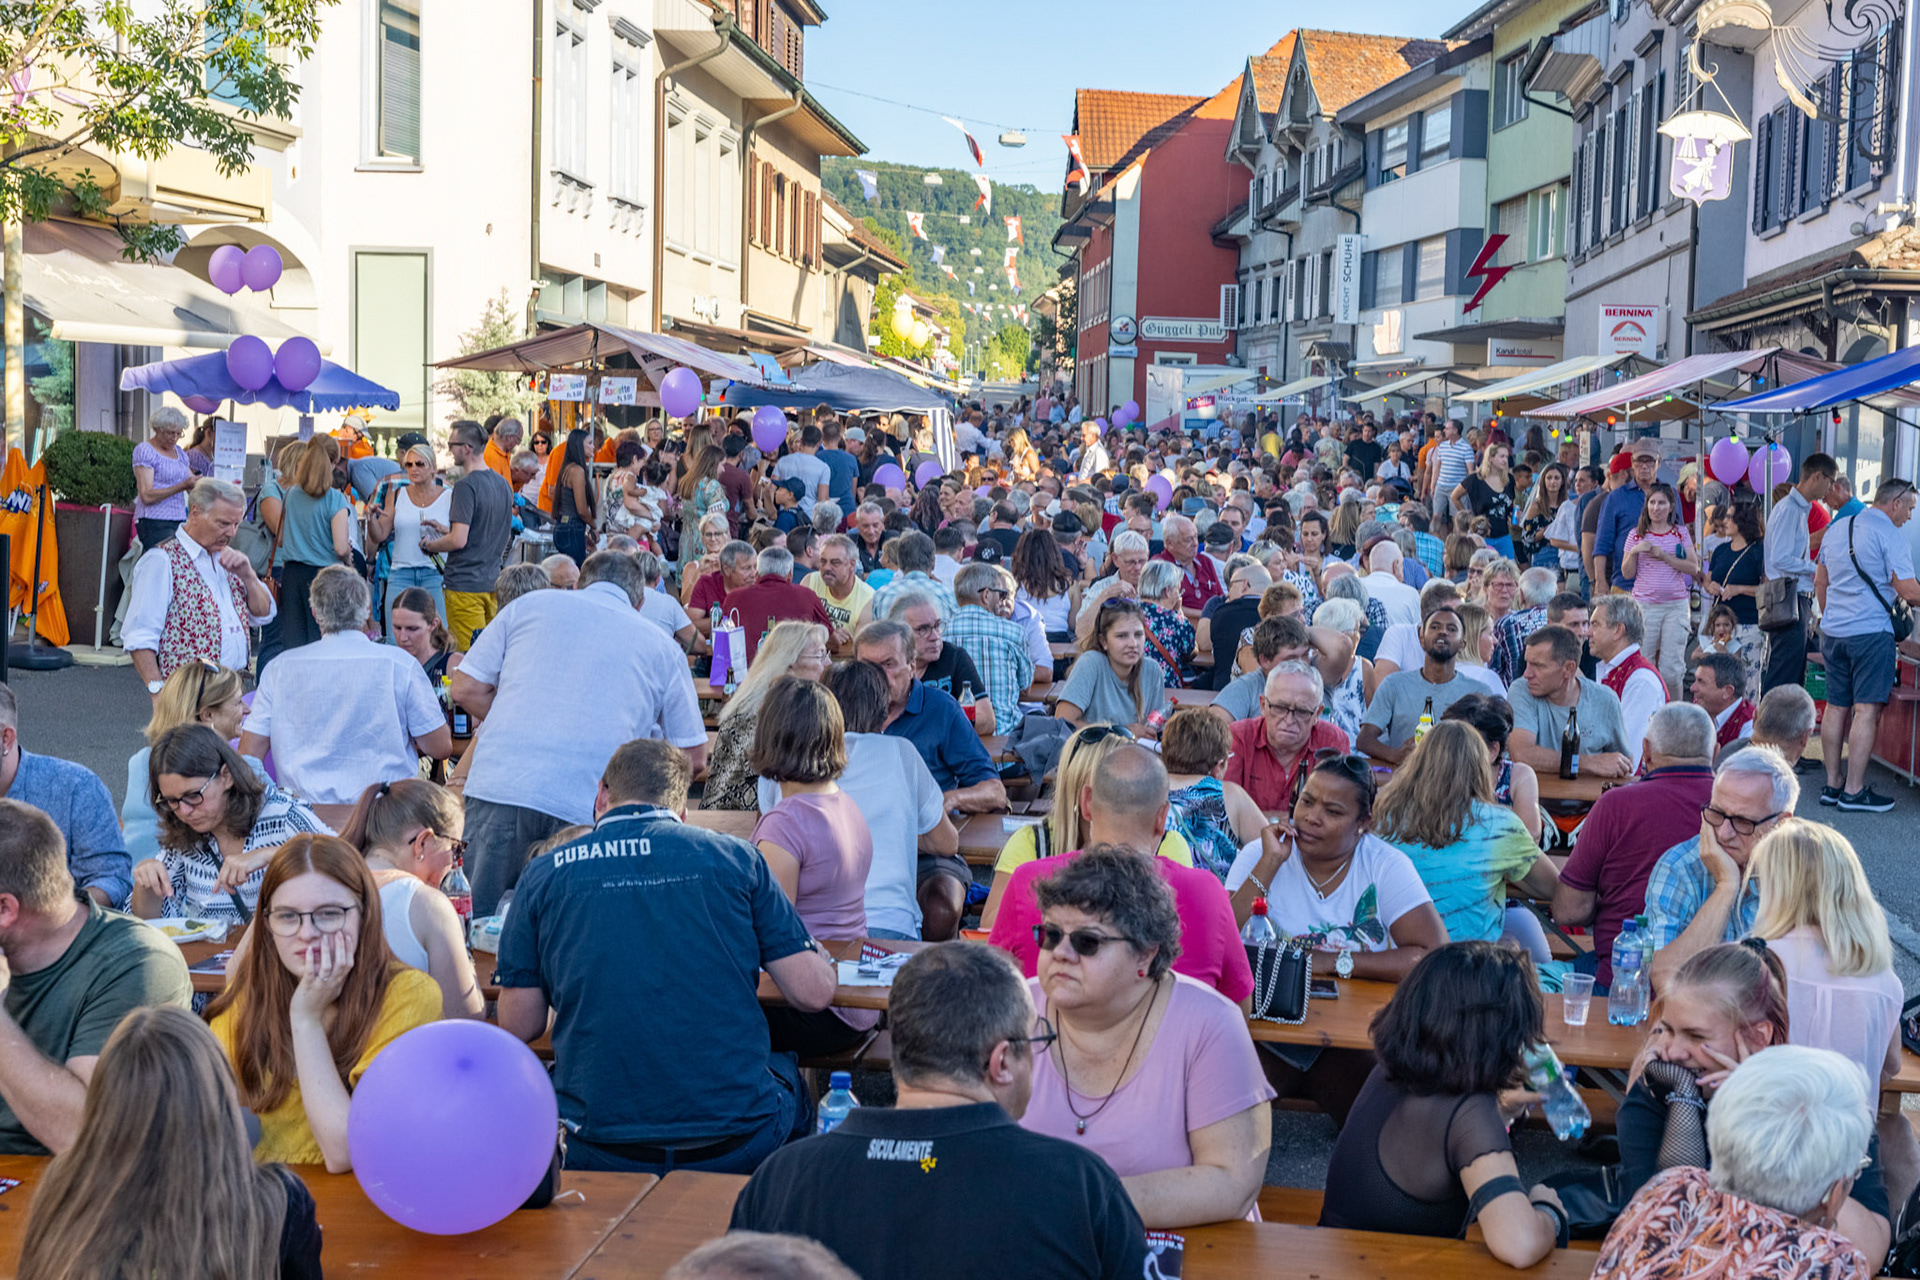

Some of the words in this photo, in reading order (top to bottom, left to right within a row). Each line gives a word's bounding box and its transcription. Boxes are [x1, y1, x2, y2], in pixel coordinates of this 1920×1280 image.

[1343, 237, 1353, 282] SCHUHE
[1605, 308, 1653, 317] BERNINA
[1145, 322, 1192, 336] Güggeli
[1198, 323, 1223, 337] Pub
[1495, 347, 1516, 355] Kanal
[1517, 347, 1533, 355] total
[554, 838, 652, 868] CUBANITO
[867, 1138, 934, 1161] SICULAMENTE
